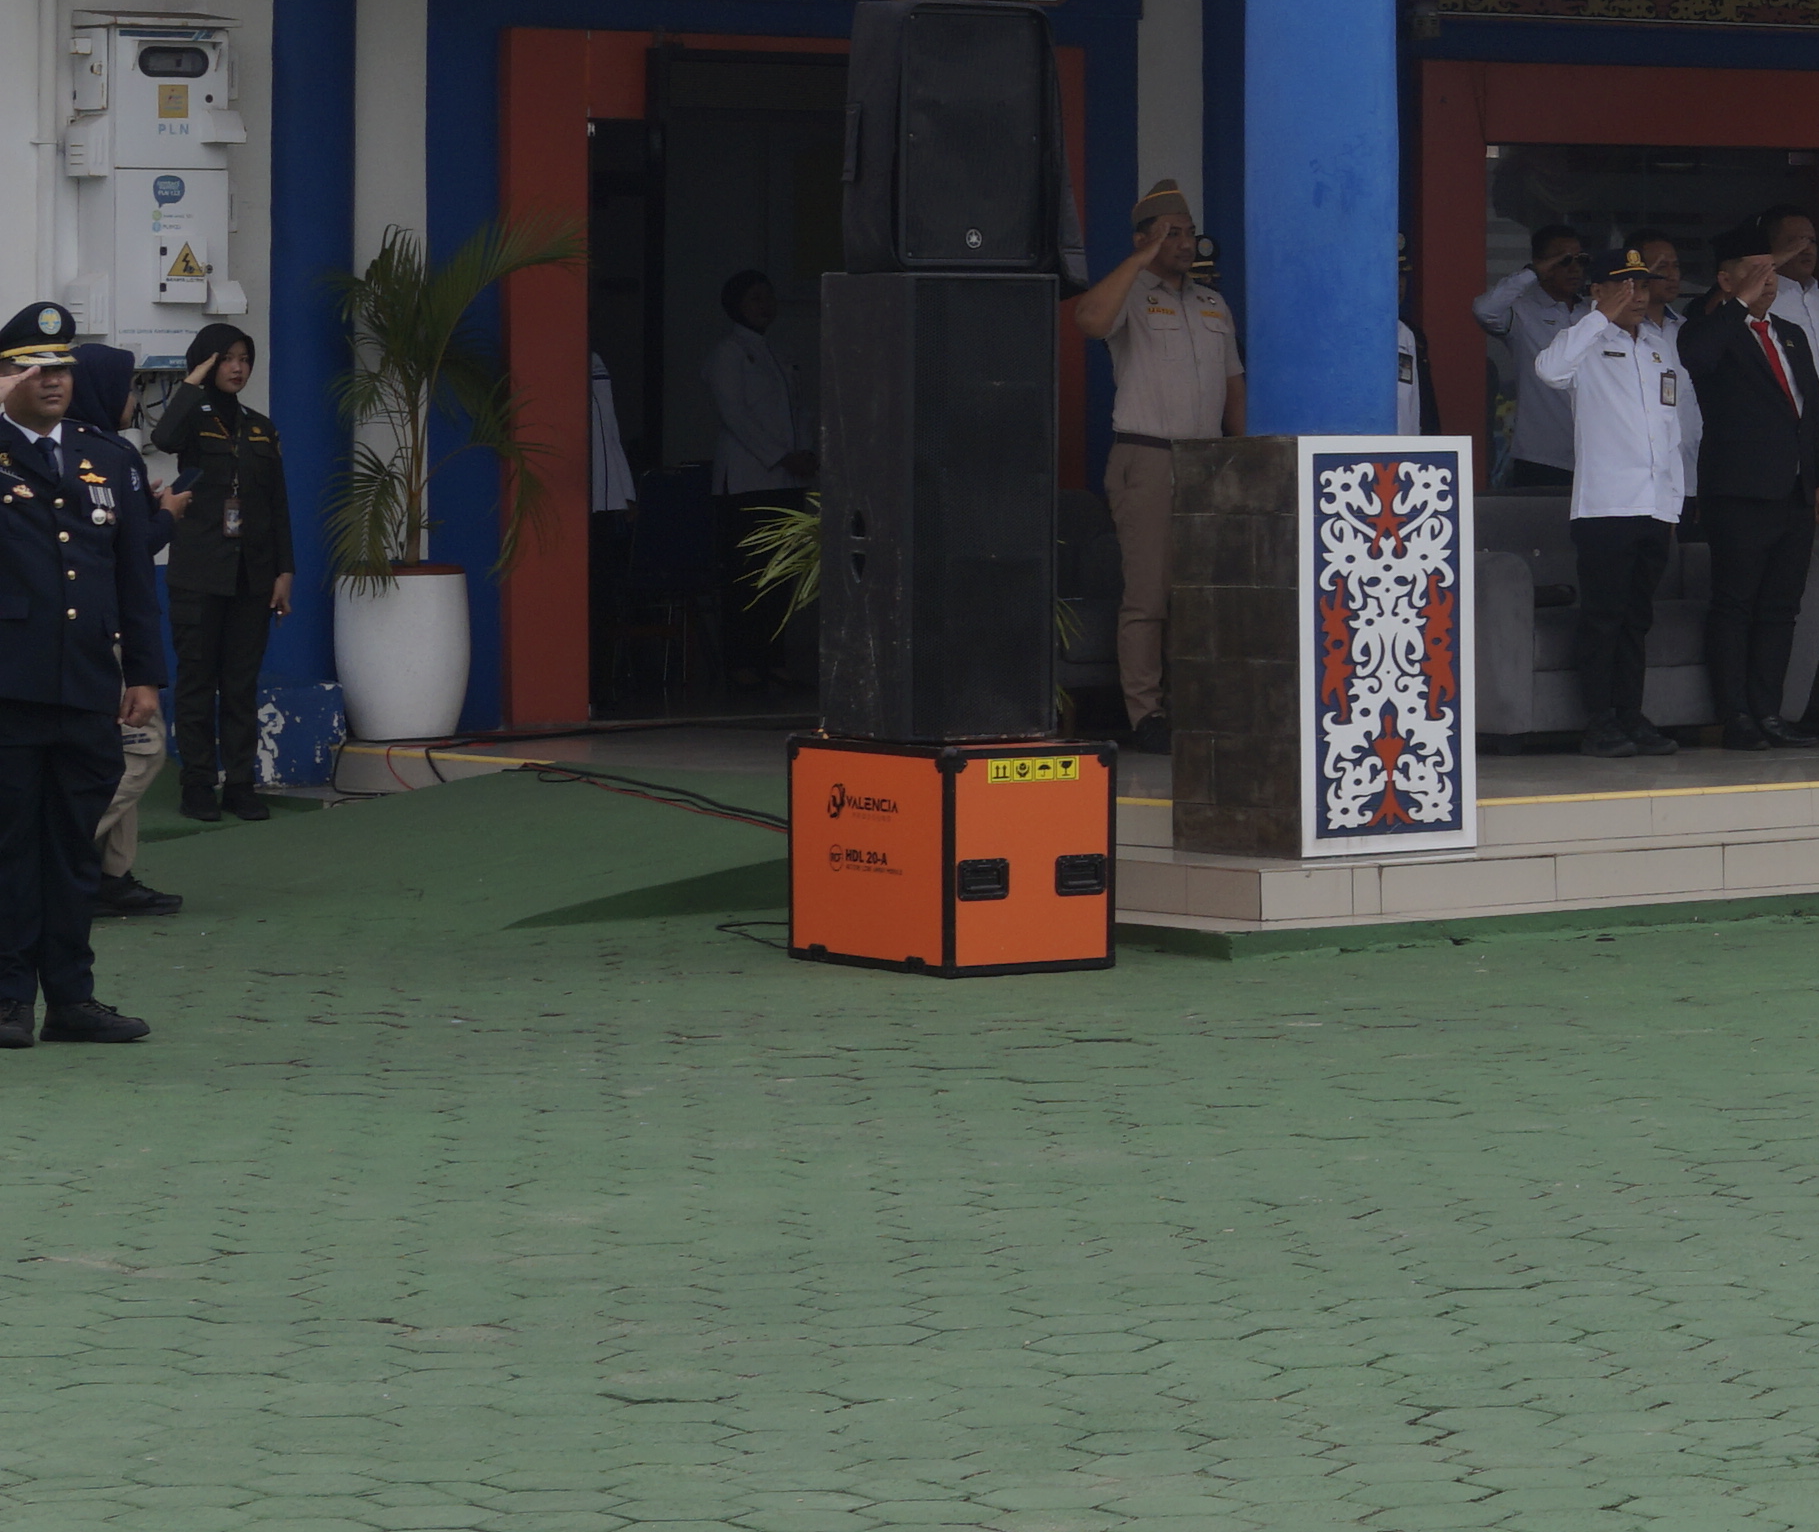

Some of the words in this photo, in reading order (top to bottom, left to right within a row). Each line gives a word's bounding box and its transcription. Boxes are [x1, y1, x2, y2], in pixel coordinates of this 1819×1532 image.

[158, 123, 190, 136] PLN
[846, 795, 899, 814] VALENCIA
[845, 849, 865, 864] HDL
[865, 851, 888, 866] 20-A
